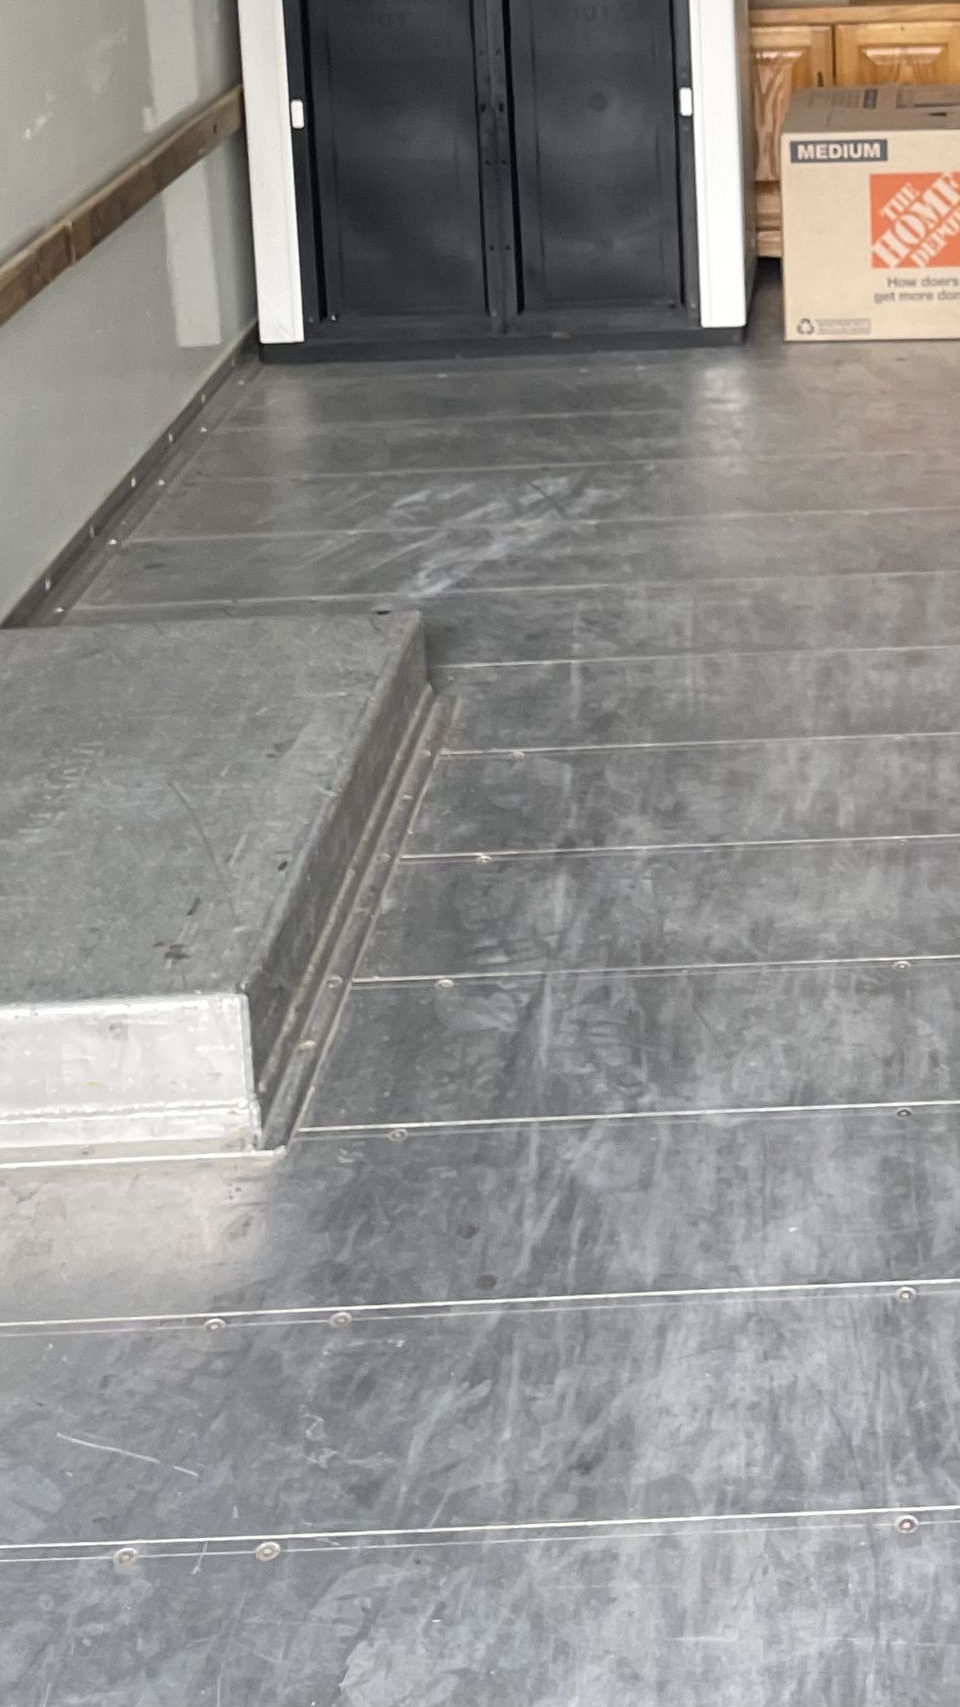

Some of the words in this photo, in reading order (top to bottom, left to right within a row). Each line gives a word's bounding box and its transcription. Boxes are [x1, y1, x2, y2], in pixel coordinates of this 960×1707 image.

[797, 142, 881, 160] MEDIUM
[879, 181, 921, 221] THE
[886, 276, 917, 288] How
[920, 275, 960, 288] doers
[873, 291, 896, 304] get
[899, 291, 934, 302] more
